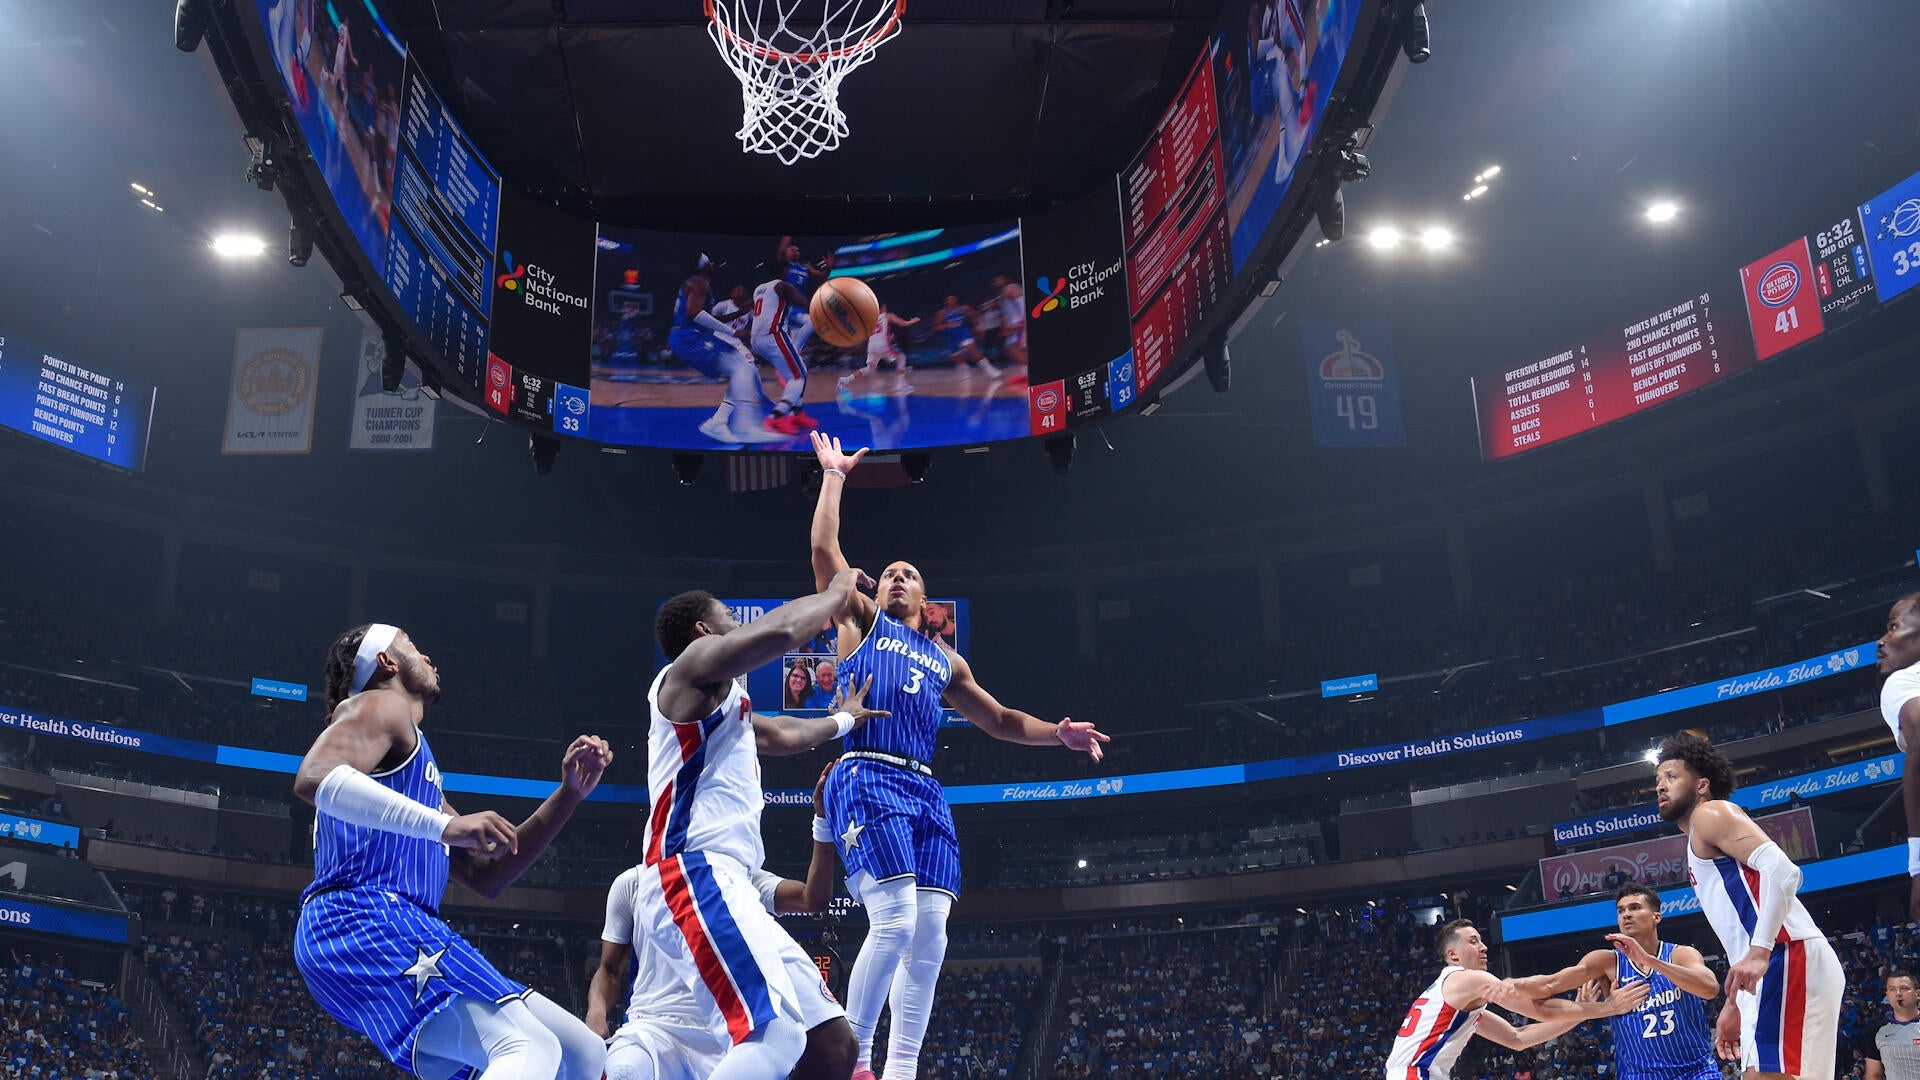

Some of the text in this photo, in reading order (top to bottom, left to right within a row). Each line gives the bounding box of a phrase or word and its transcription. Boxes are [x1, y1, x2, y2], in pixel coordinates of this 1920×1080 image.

[1864, 204, 1871, 215] 8
[1816, 218, 1853, 249] 6:32
[1820, 234, 1855, 259] 2ND QTR
[1856, 245, 1862, 255] 4
[1068, 261, 1096, 280] City
[1818, 265, 1823, 275] 1
[1832, 254, 1848, 268] FLS
[1858, 256, 1865, 266] 5
[1892, 242, 1920, 276] 33
[527, 264, 555, 285] City
[1068, 257, 1122, 294] National
[1745, 268, 1750, 277] 1
[1766, 273, 1791, 288] DETROIT
[1820, 276, 1826, 285] 4
[1834, 265, 1850, 278] TOL
[1836, 274, 1853, 288] CHL
[1861, 267, 1866, 276] 1
[526, 278, 588, 309] National
[1069, 286, 1105, 309] Bank
[1767, 279, 1793, 296] PISTONS
[1822, 285, 1828, 295] 1
[1822, 283, 1874, 313] LUNAZUL
[525, 292, 561, 316] Bank
[1624, 293, 1710, 338] POINTS IN THE PAINT 20
[1626, 308, 1709, 351] 2ND CHANCE POINTS 7
[1774, 306, 1799, 334] 41
[1628, 322, 1713, 365] FAST BREAK POINTS 6
[1505, 345, 1586, 382] OFFENSIVE REBOUNDS 4
[1630, 335, 1715, 378] POINTS OFF TURNOVERS 3
[43, 354, 124, 393] POINTS IN THE PAINT 14
[523, 375, 541, 388] 6:32
[1078, 372, 1096, 385] 6:32
[1507, 358, 1589, 395] DEFENSIVE REBOUNDS 14
[1633, 350, 1718, 392] BENCH POINTS 9
[40, 368, 121, 405] 2ND CHANCE POINTS 6
[1119, 386, 1131, 403] 33
[1508, 372, 1591, 408] TOTAL REBOUNDS 18
[1635, 363, 1720, 405] TURNOVERS 8
[38, 381, 119, 418] FAST BREAK POINTS 9
[491, 389, 501, 405] 41
[1510, 384, 1593, 421] ASSISTS 10
[36, 394, 118, 431] POINTS OFF TURNOVERS 12
[366, 406, 424, 419] TURNER CUP
[563, 416, 579, 432] 33
[1041, 414, 1055, 428] 41
[1336, 395, 1378, 430] 49
[1512, 399, 1594, 435] BLOCKS 6
[32, 420, 74, 444] TURNOVERS
[34, 408, 115, 445] BENCH POINTS 10
[268, 431, 298, 439] CENTER
[365, 419, 420, 431] CHAMPIONS
[370, 434, 412, 444] 2000-2001
[1514, 431, 1541, 447] STEALS
[903, 667, 925, 695] 3
[1717, 664, 1823, 699] Florida Blue
[20, 713, 69, 735] Health
[71, 723, 141, 747] Solutions
[1338, 729, 1523, 767] Discover Health Solutions
[764, 792, 814, 804] Solutio
[1002, 783, 1093, 799] Florida Blue
[1760, 771, 1860, 803] Florida Blue
[1595, 813, 1664, 833] Solutions
[1553, 862, 1606, 894] WALT
[1398, 997, 1430, 1037] 5
[1643, 1010, 1675, 1039] 23
